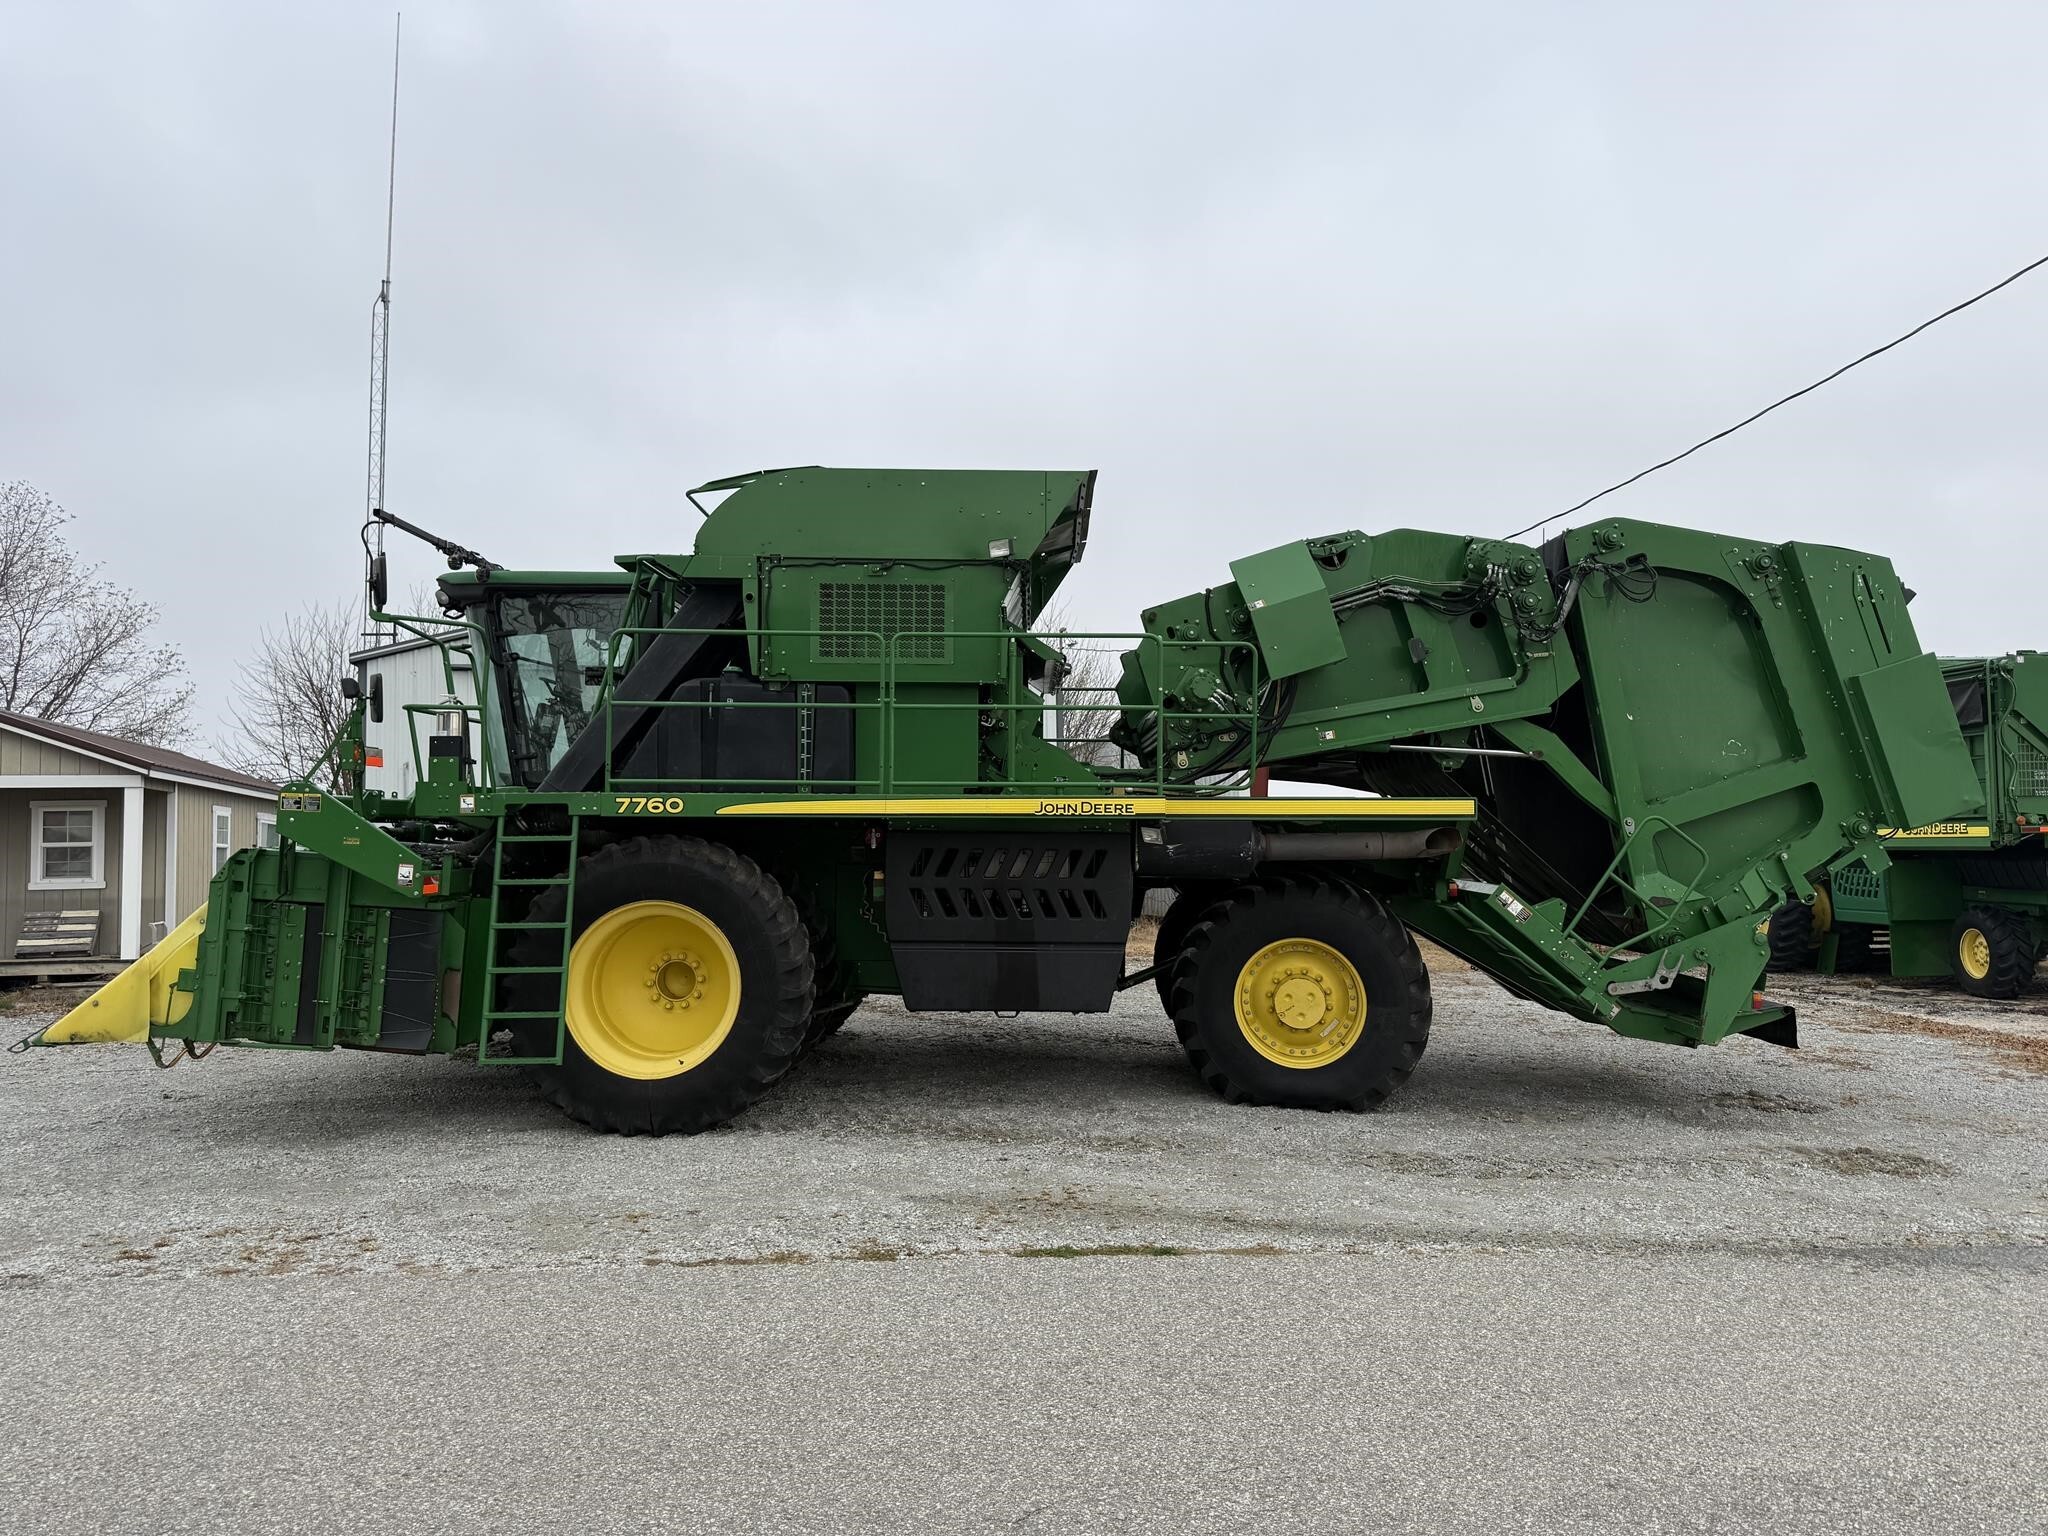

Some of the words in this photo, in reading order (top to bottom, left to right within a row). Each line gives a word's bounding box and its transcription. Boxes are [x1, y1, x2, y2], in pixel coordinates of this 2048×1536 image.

[615, 797, 684, 814] 7760
[1034, 801, 1078, 814] JOHN
[1080, 801, 1134, 814] DEERE
[1932, 822, 1968, 834] DEERE
